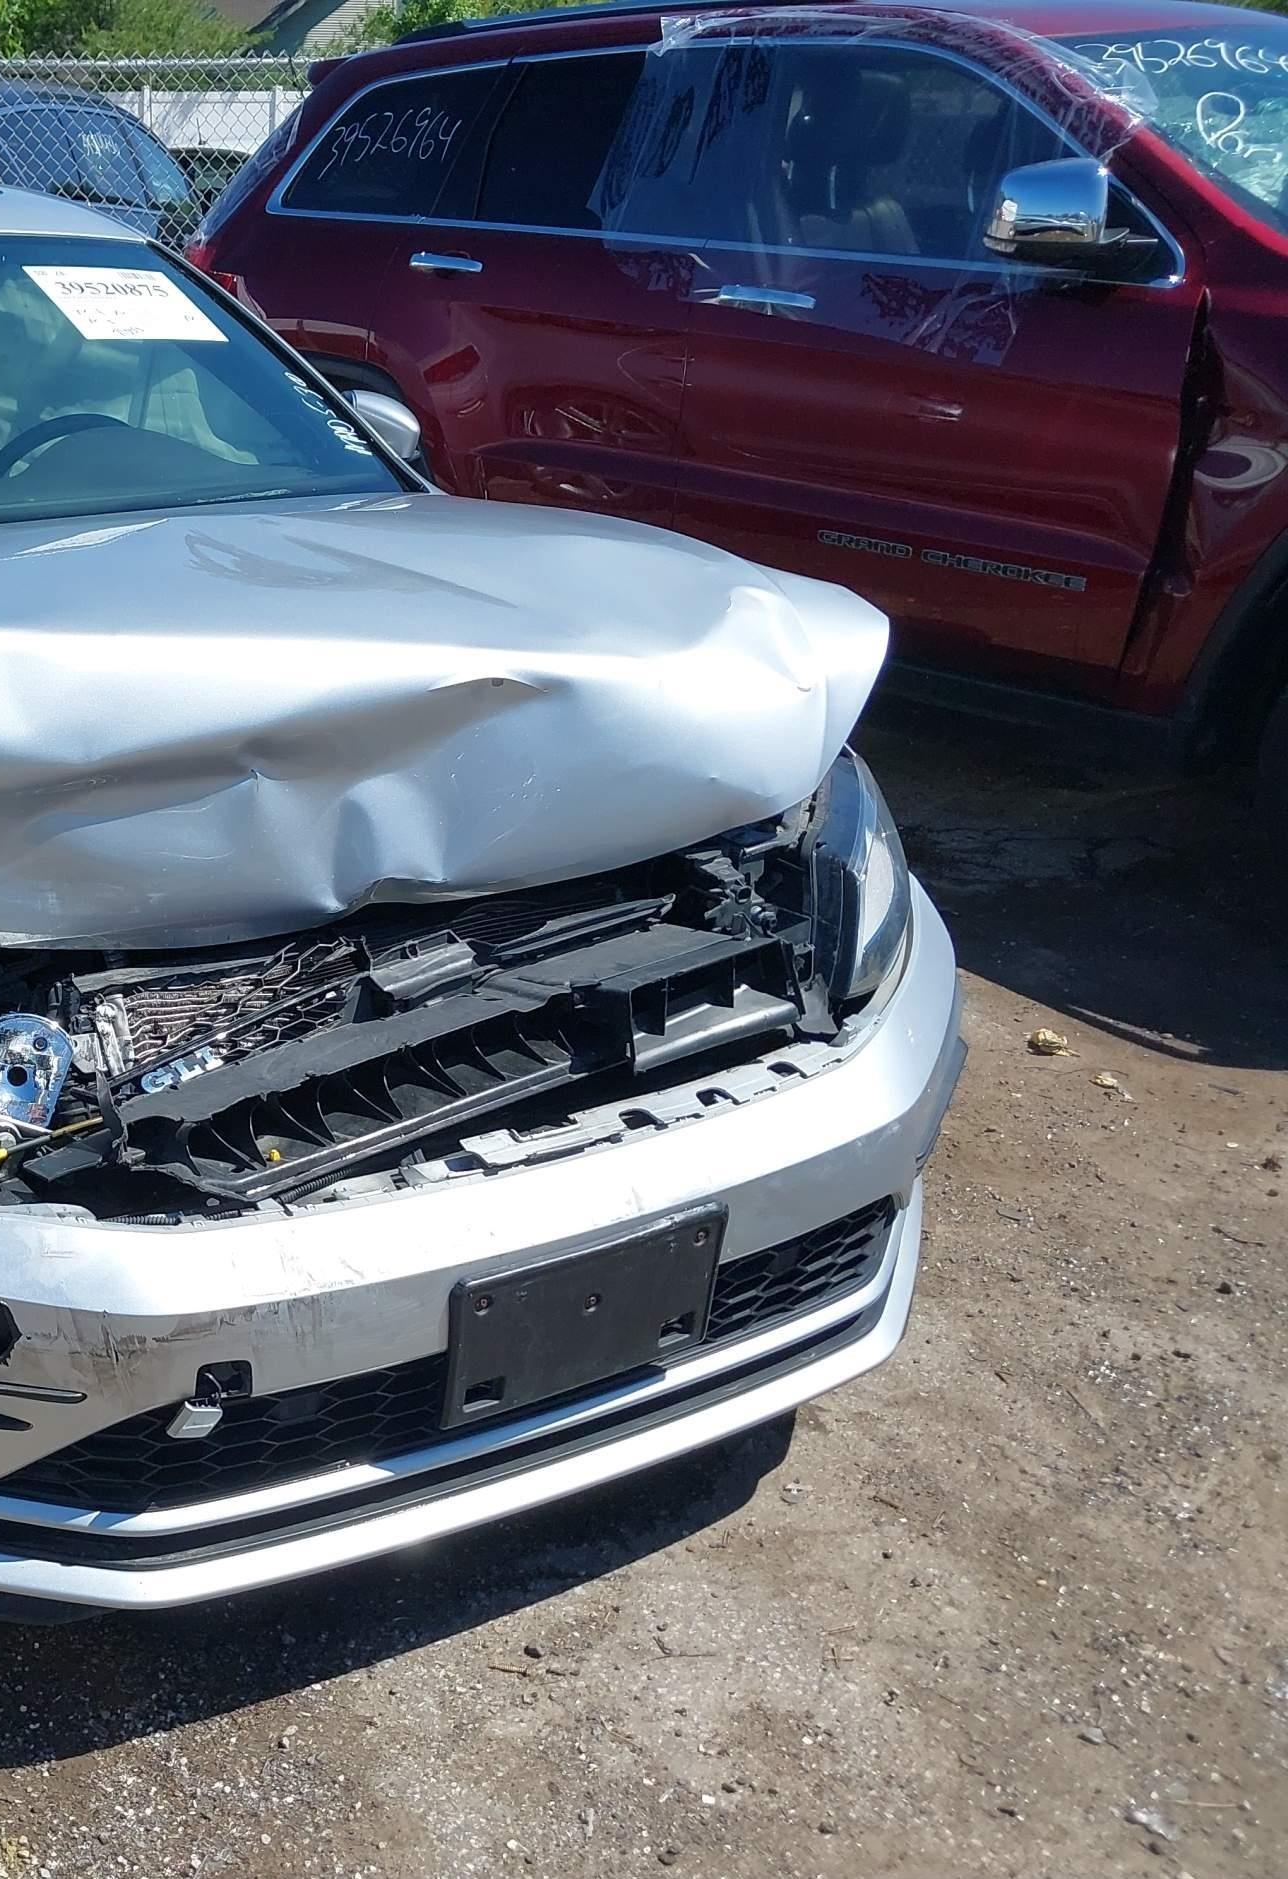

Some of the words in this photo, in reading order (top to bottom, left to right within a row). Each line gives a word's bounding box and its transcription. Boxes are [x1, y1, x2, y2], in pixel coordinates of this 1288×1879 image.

[317, 107, 462, 180] 39526964
[55, 281, 169, 298] 39520875
[817, 529, 912, 558] GRAND
[921, 549, 1087, 592] CHEROKEE
[141, 1046, 225, 1094] GLI
